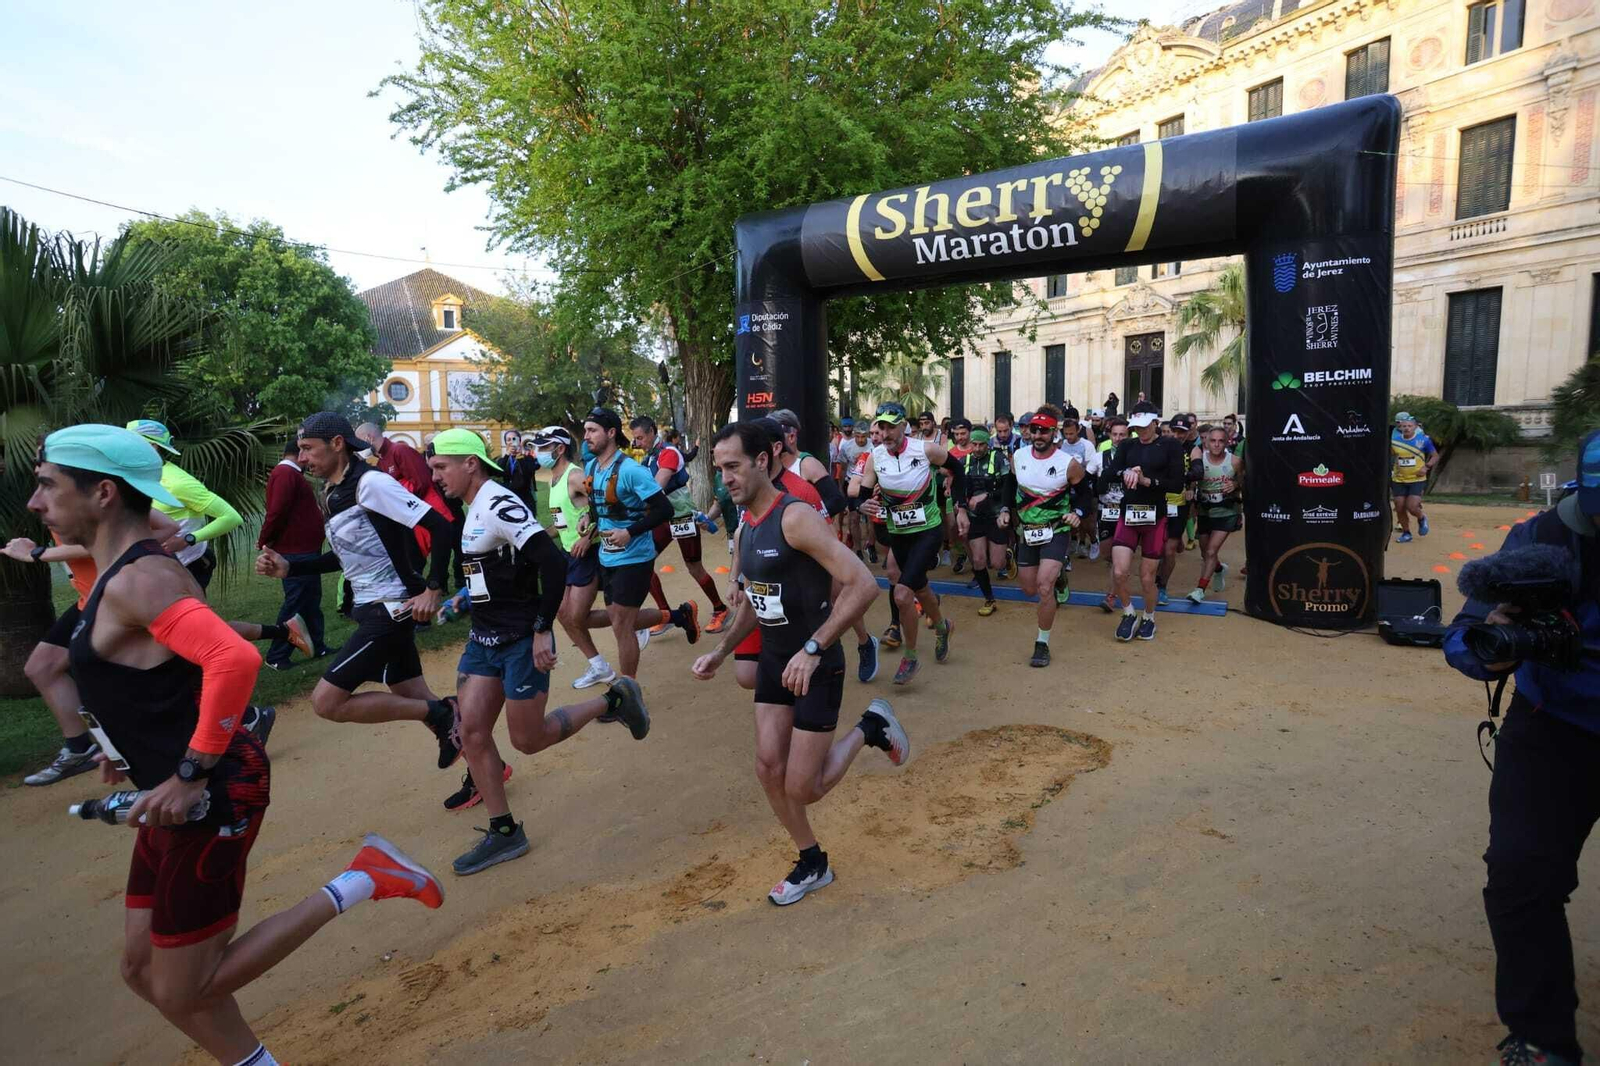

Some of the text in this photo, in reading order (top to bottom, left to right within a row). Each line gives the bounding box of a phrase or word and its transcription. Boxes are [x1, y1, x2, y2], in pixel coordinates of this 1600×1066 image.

[913, 215, 1079, 265] Maratón
[1302, 256, 1371, 270] Ayuntamiento
[1302, 267, 1344, 279] de Jerez
[1306, 304, 1339, 316] JEREZ
[751, 312, 789, 322] Diputación
[752, 324, 761, 332] de
[1330, 315, 1339, 341] WINES
[1305, 340, 1339, 350] SHERRY
[1304, 368, 1372, 383] BELCHIM
[747, 391, 774, 404] HSN
[1299, 474, 1342, 485] Primeale
[898, 510, 917, 521] 142
[1132, 511, 1148, 519] 112
[673, 523, 690, 532] 246
[1031, 529, 1044, 538] 48
[1277, 582, 1362, 609] Sherry
[752, 595, 767, 612] 53
[1304, 602, 1348, 612] Promo
